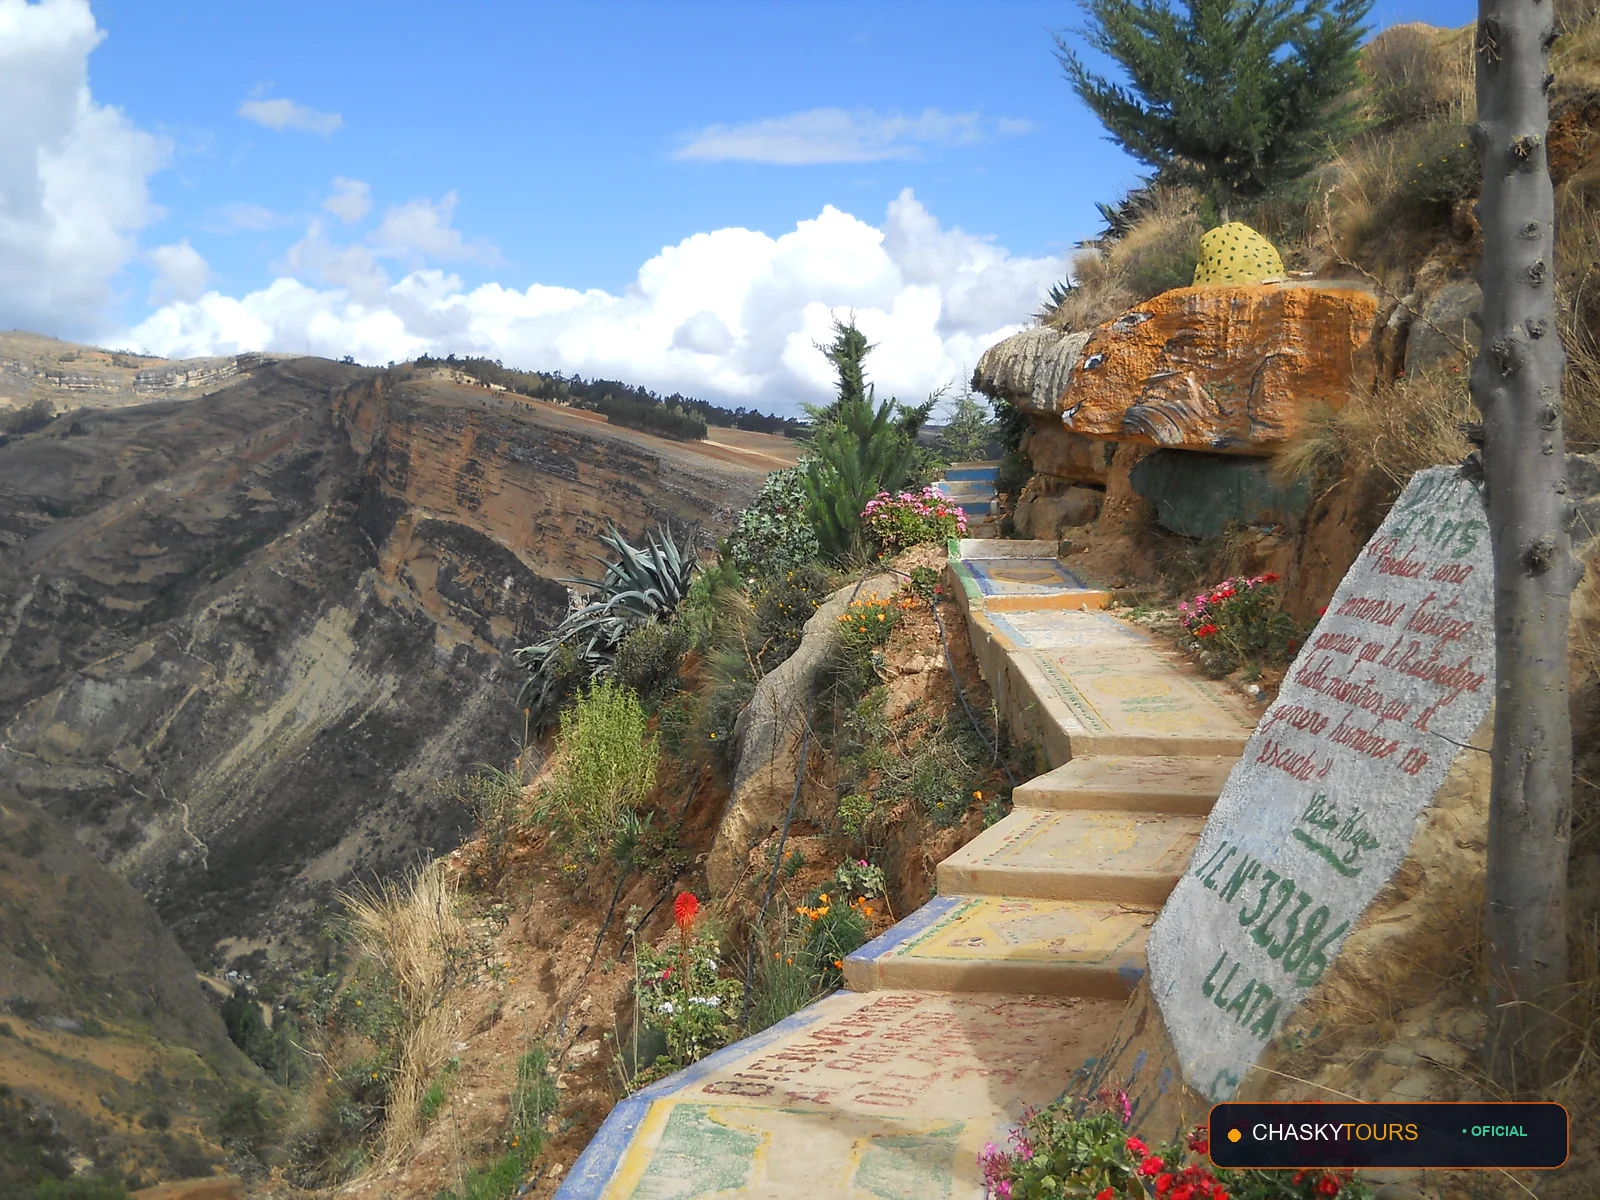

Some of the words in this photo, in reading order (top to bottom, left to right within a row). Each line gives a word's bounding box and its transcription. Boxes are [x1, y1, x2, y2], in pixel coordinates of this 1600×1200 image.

[1428, 564, 1474, 585] una
[1347, 641, 1385, 676] que
[1238, 868, 1351, 988] 32386
[1202, 951, 1284, 1041] LLATA
